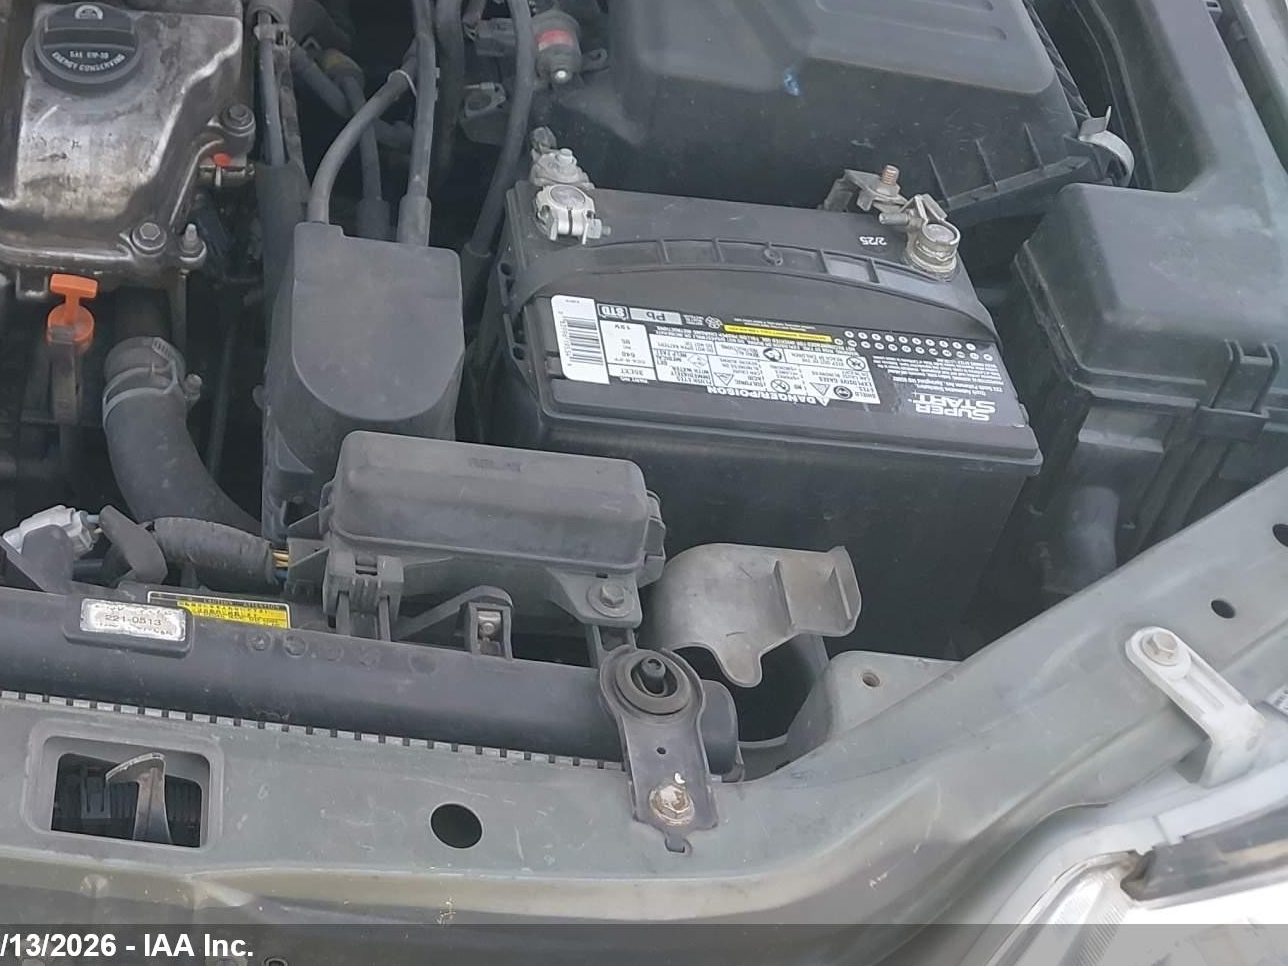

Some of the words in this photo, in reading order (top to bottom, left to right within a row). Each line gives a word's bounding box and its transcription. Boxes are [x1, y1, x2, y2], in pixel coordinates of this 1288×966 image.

[601, 306, 624, 316] STD
[646, 311, 665, 320] Pb
[707, 385, 817, 405] DANGER/POISON
[105, 614, 162, 626] 221-0513
